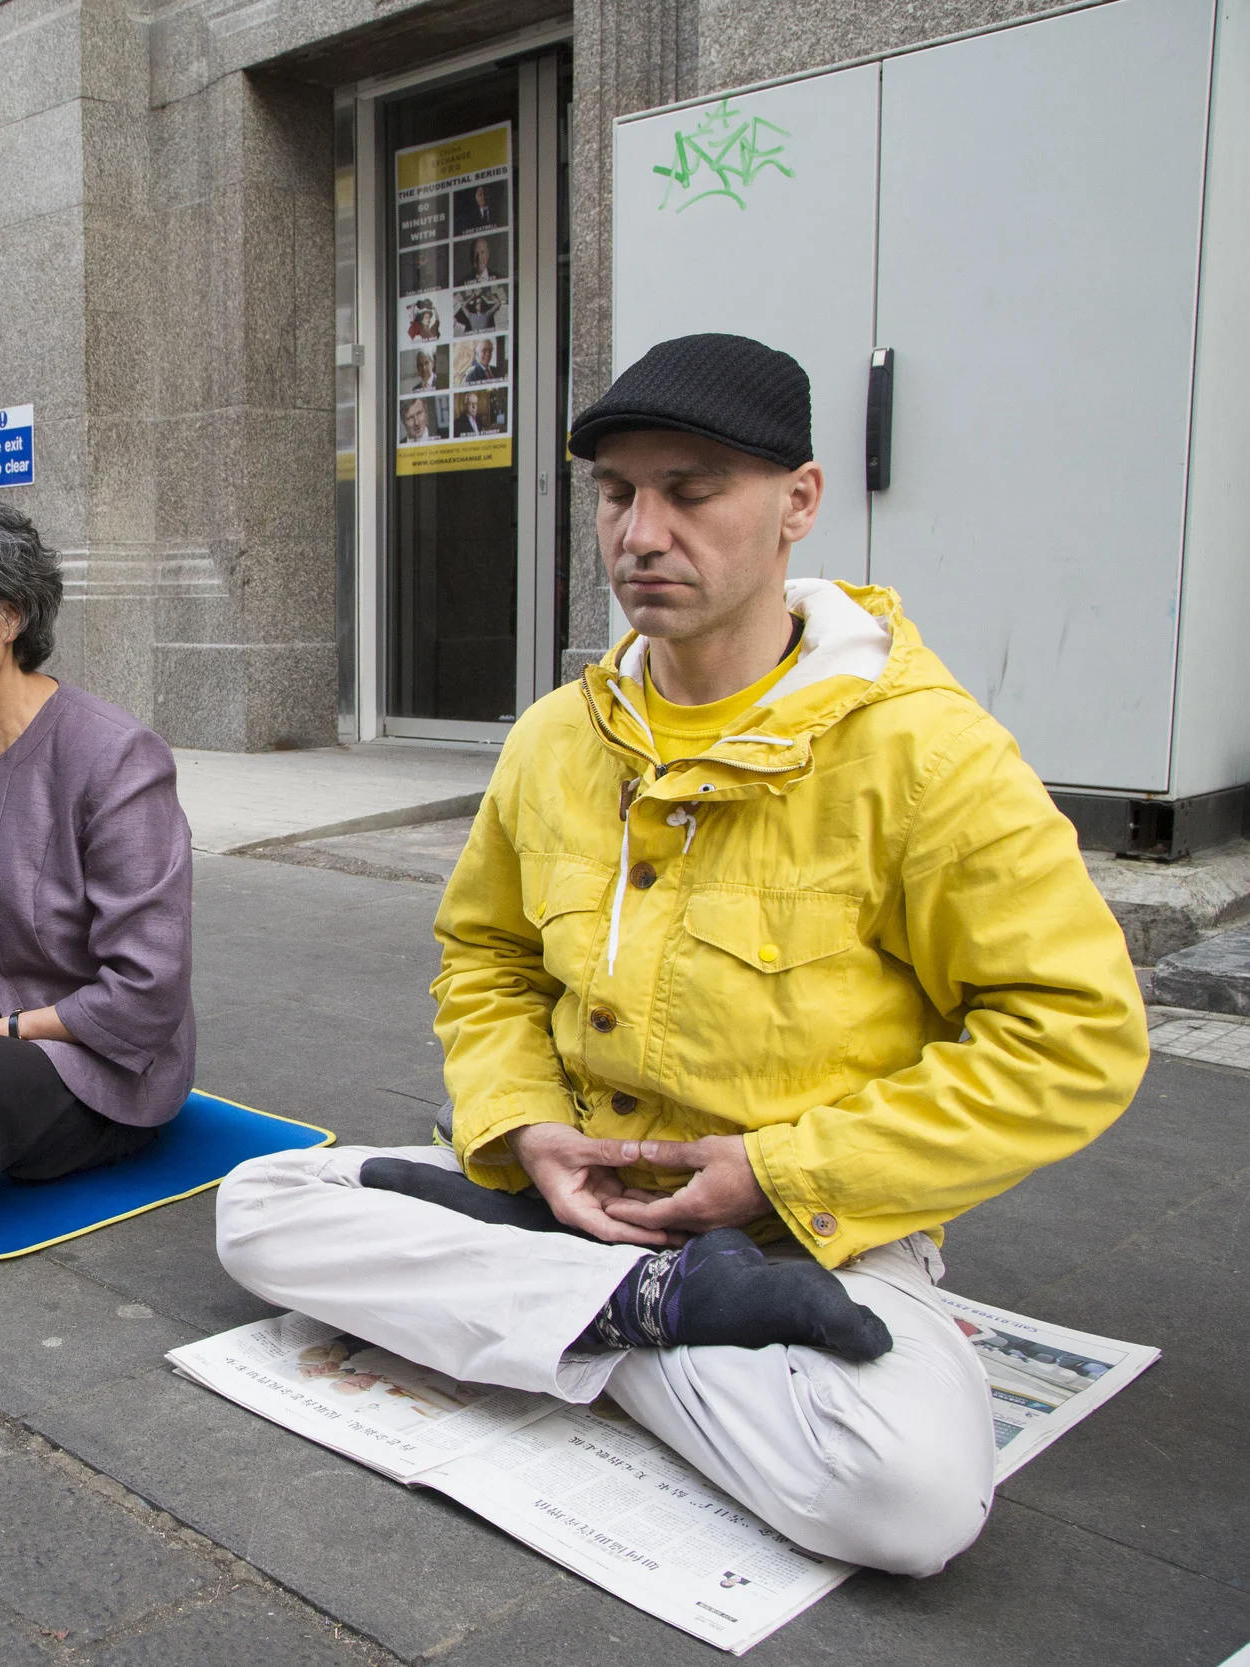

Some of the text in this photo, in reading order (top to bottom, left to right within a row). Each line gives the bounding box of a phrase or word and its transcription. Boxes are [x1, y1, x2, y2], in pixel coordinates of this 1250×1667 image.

[431, 151, 471, 168] EXCHANGE
[398, 166, 508, 199] THE PRUDENTIAL SERIES
[418, 202, 430, 212] 60
[402, 213, 446, 230] MINUTES
[411, 230, 436, 241] WITH
[5, 436, 23, 452] exit
[5, 458, 29, 474] clear
